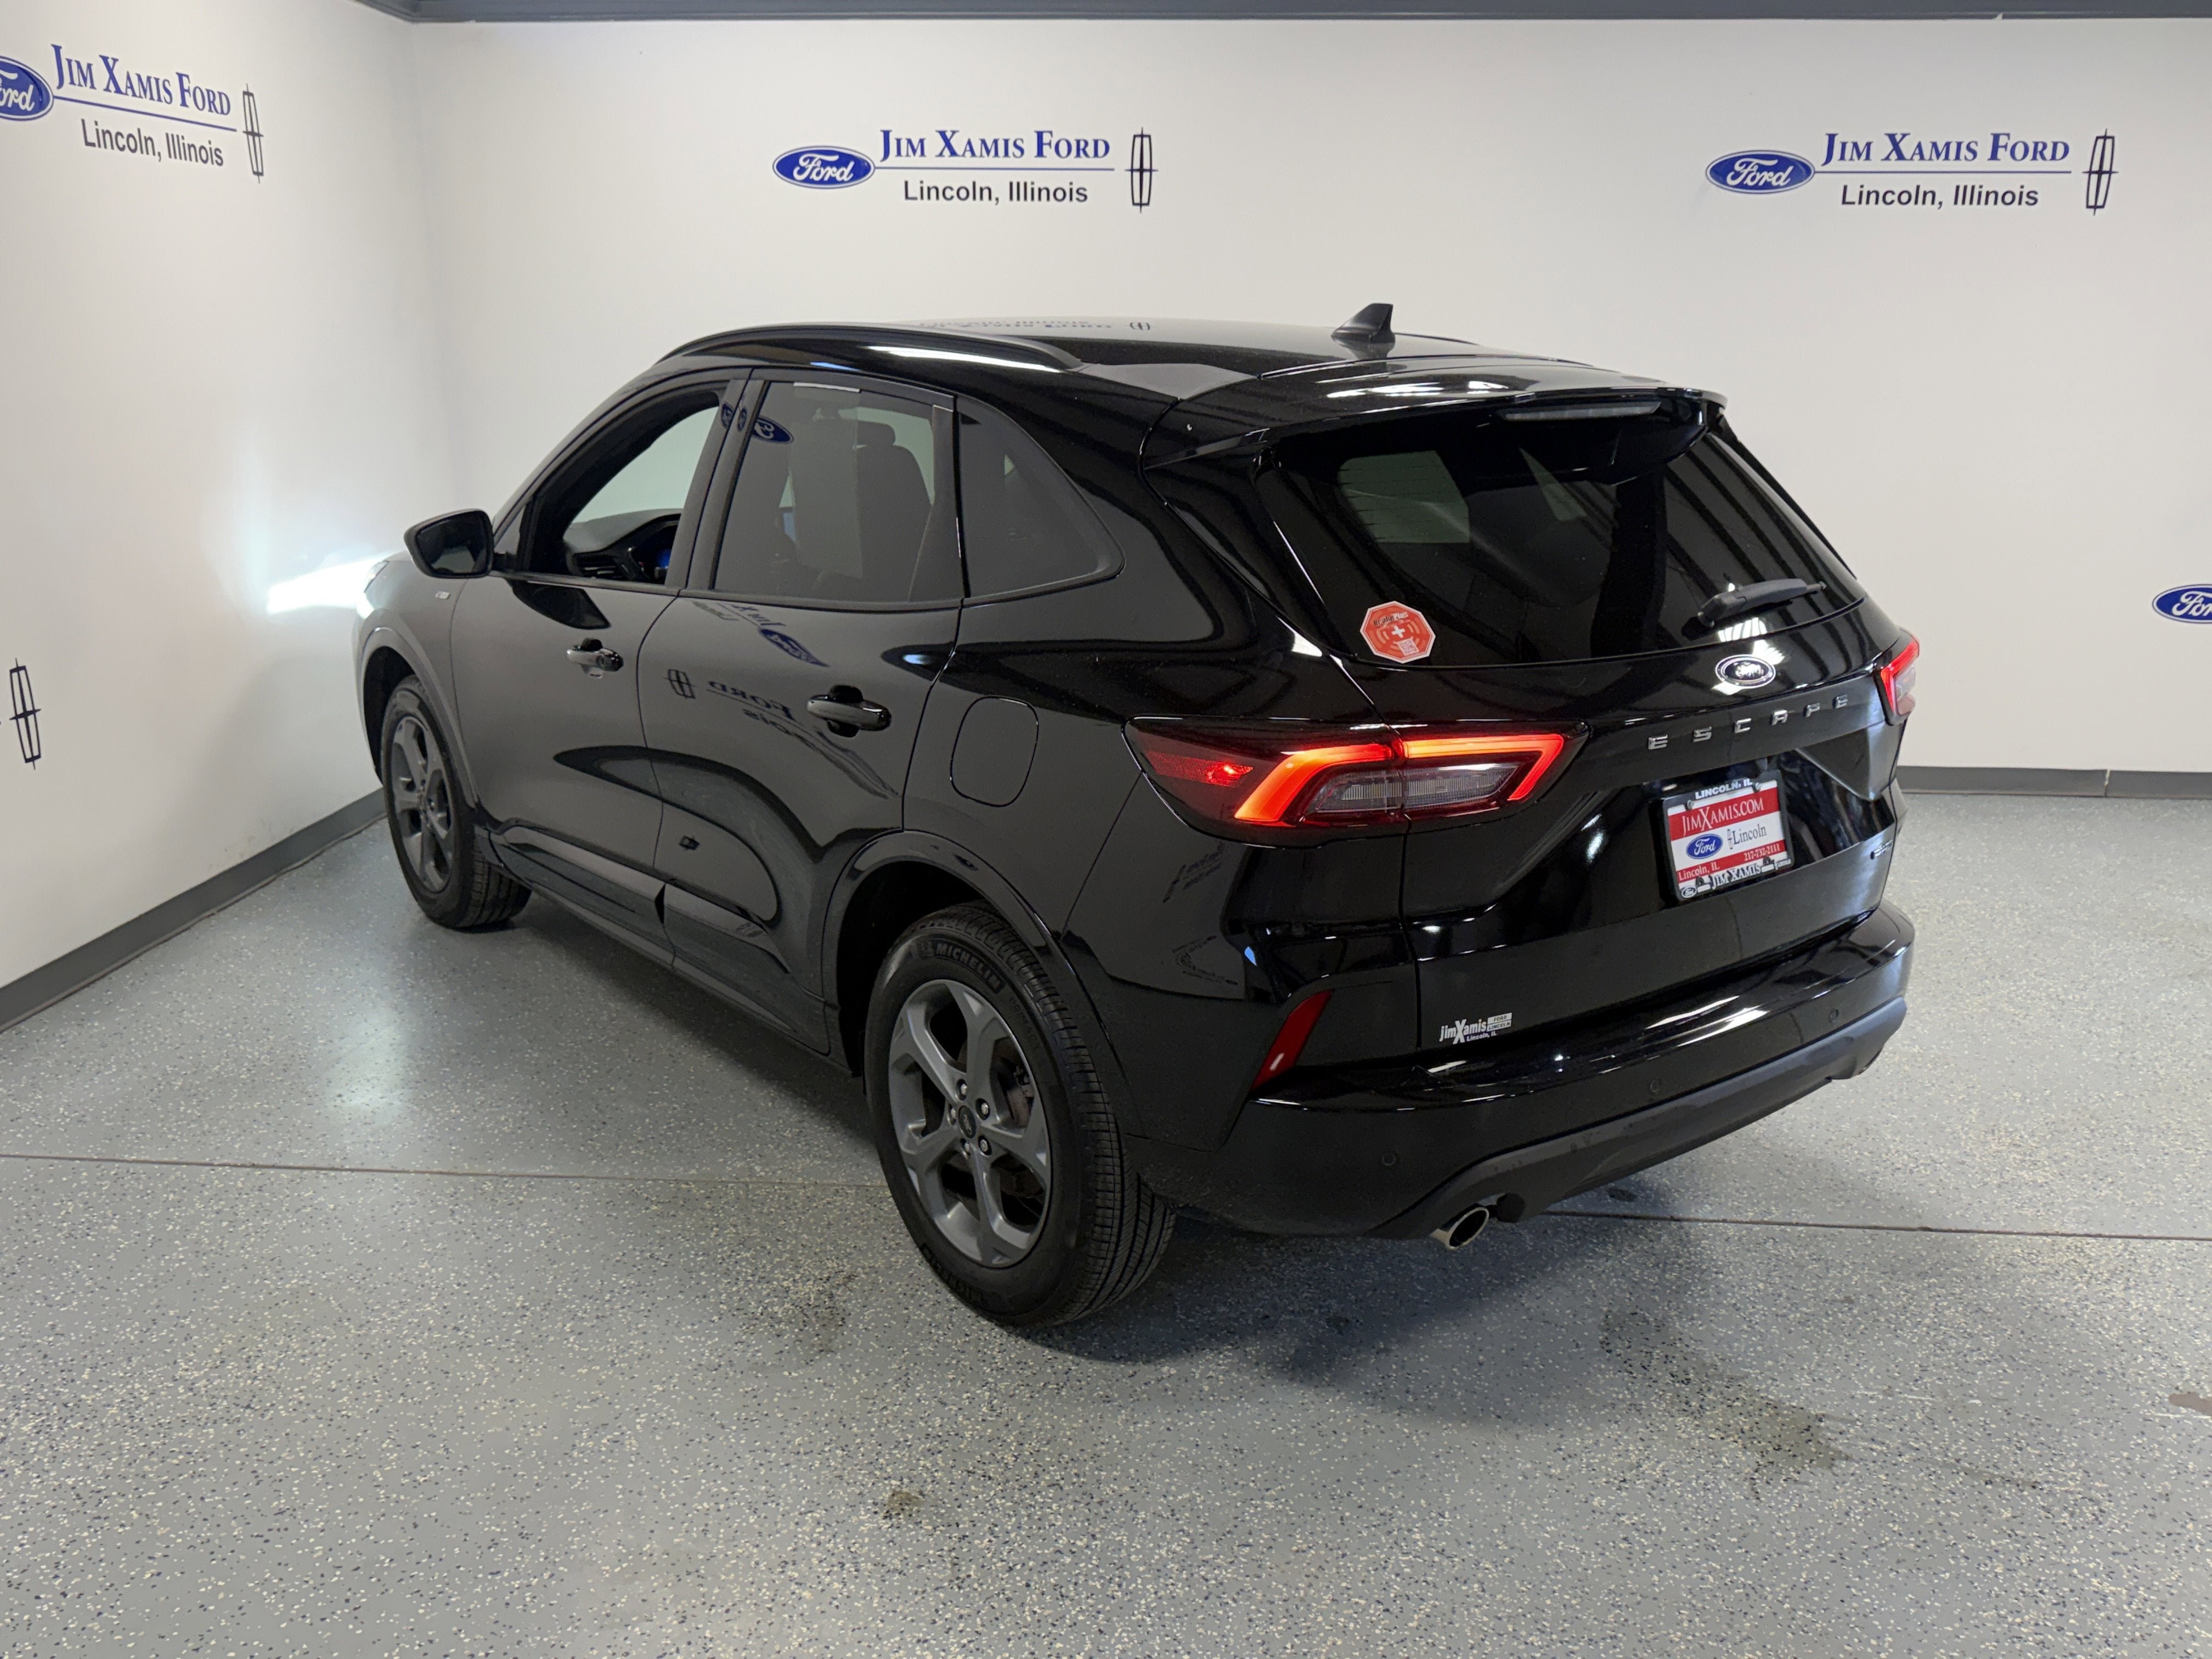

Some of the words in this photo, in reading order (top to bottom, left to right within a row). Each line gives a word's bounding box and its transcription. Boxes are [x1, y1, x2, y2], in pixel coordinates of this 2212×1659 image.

[0, 69, 35, 111] ord
[50, 43, 97, 89] JIM
[99, 54, 173, 104] XAMIS
[176, 72, 231, 115] FORD
[81, 119, 161, 162] Lincoln,
[165, 133, 223, 167] Illinois
[880, 129, 926, 162] JIM
[935, 130, 1025, 159] XAMIS
[1034, 130, 1110, 159] FORD
[1821, 133, 1873, 166] JIM
[1881, 133, 1978, 161] XAMIS
[1987, 133, 2069, 161] FORD
[793, 153, 855, 182] Ford
[1726, 157, 1794, 187] Ford
[904, 180, 999, 206] Lincoln,
[1009, 181, 1088, 202] Illinois
[1841, 184, 1943, 210] Lincoln,
[1953, 184, 2039, 206] Illinois
[1647, 694, 1849, 751] ESCAPE
[1695, 782, 1741, 798] LINCOLN,
[1743, 778, 1753, 787] IL
[1682, 798, 1764, 837] JIMXAMIS.COM
[1694, 838, 1716, 855] Ford
[1733, 823, 1767, 845] Lincoln
[1743, 844, 1780, 861] 217-732-2111
[1679, 863, 1709, 881] Lincoln,
[1711, 862, 1720, 871] IL
[935, 942, 1001, 988] MICHELIN
